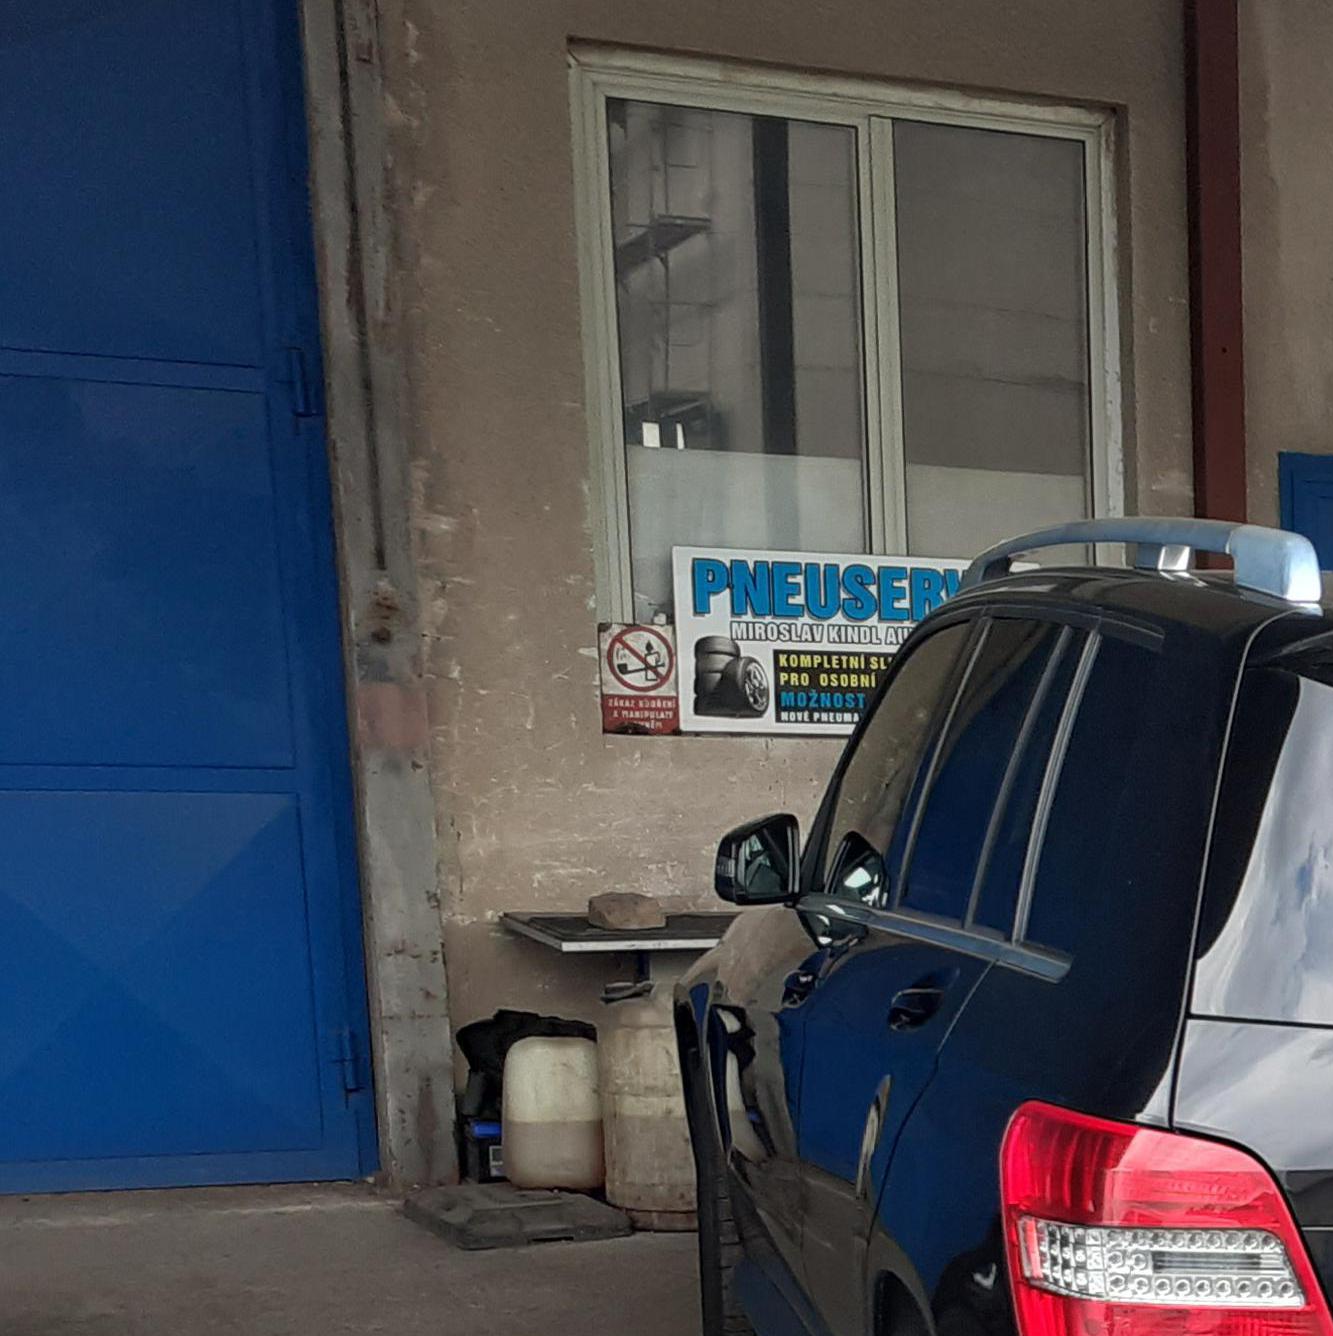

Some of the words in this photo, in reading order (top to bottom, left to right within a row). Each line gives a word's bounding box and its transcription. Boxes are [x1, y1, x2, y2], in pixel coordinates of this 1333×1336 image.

[729, 621, 824, 644] MIROSLAV
[827, 624, 882, 645] KINDL
[779, 652, 865, 670] KOMPLETNÍ
[869, 656, 892, 670] SL
[779, 673, 810, 686] PRO
[820, 673, 876, 688] OSOBNÍ
[780, 690, 866, 709] MOŽNOST
[780, 711, 810, 722] NOVÉ
